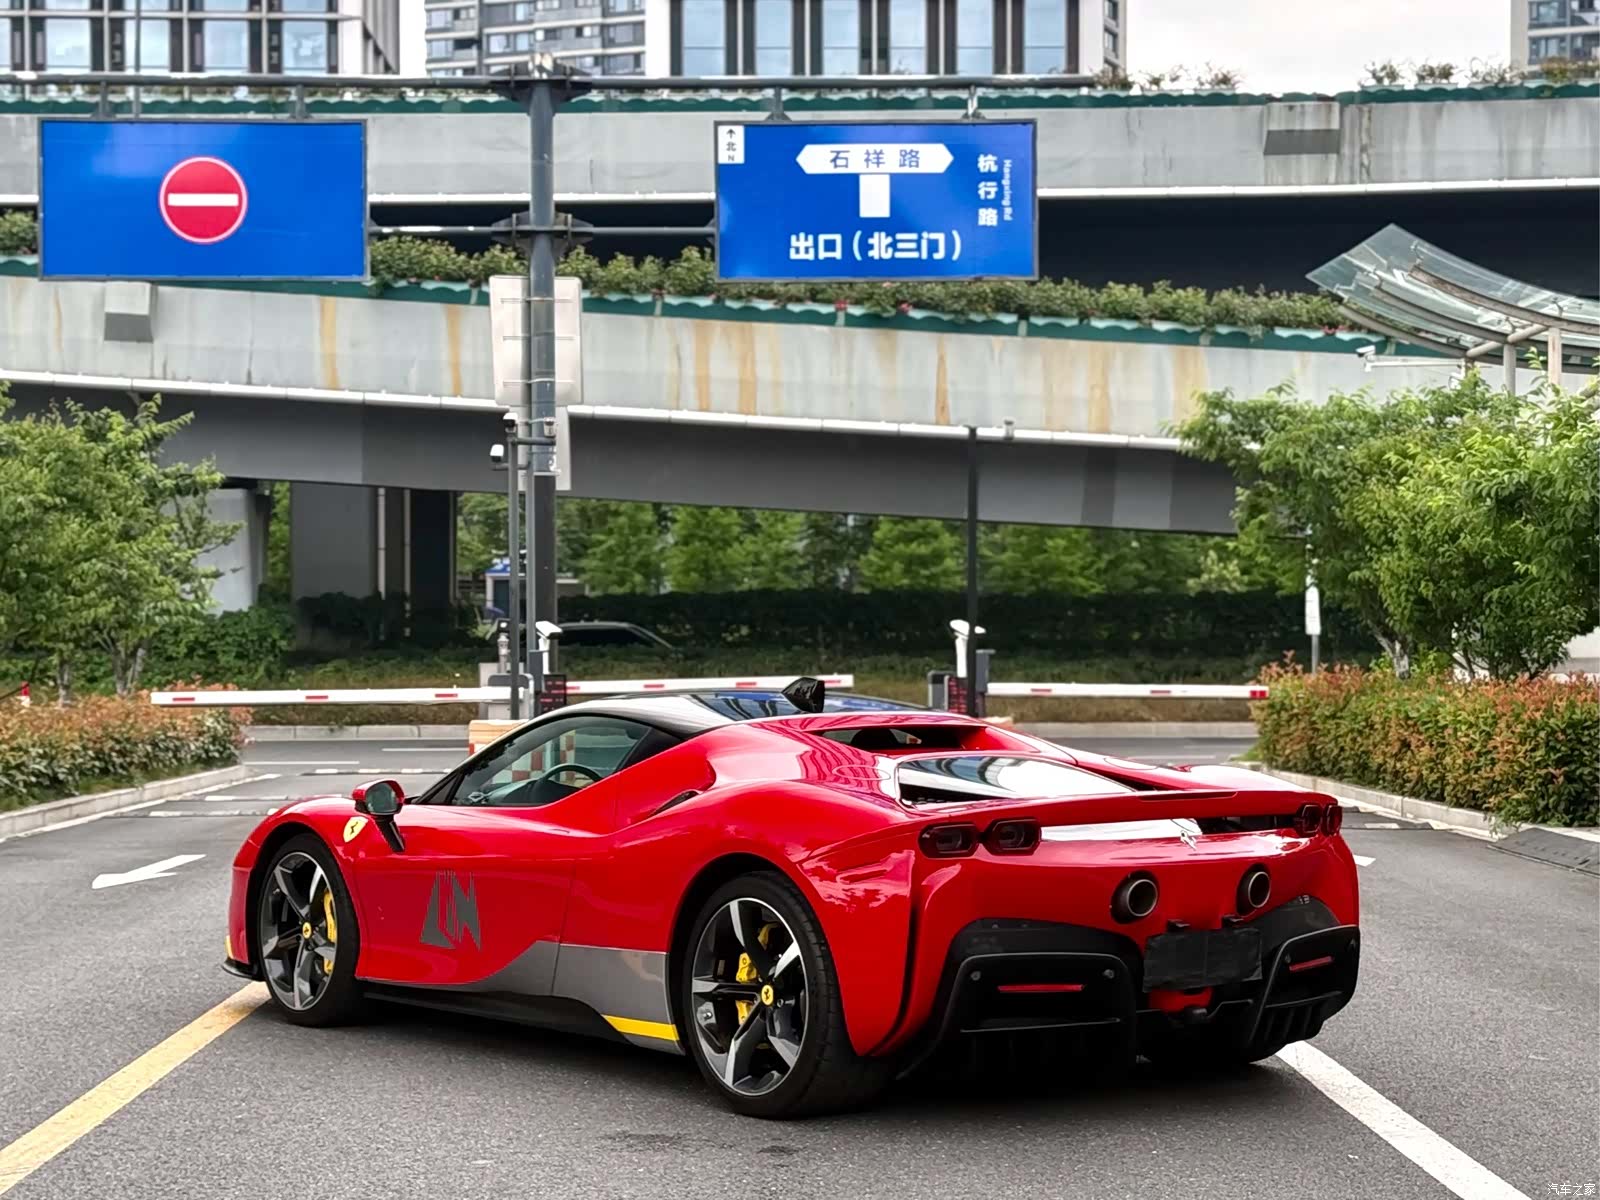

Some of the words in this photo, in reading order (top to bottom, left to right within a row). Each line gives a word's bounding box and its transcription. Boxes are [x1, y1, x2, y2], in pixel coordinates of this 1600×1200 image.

[726, 141, 737, 152] 北
[727, 154, 735, 162] N
[829, 148, 920, 169] 石祥路
[977, 153, 998, 227] 杭行路
[1001, 159, 1012, 206] Hangxing
[1003, 207, 1013, 221] Rd
[789, 230, 961, 261] 出口（北三门）
